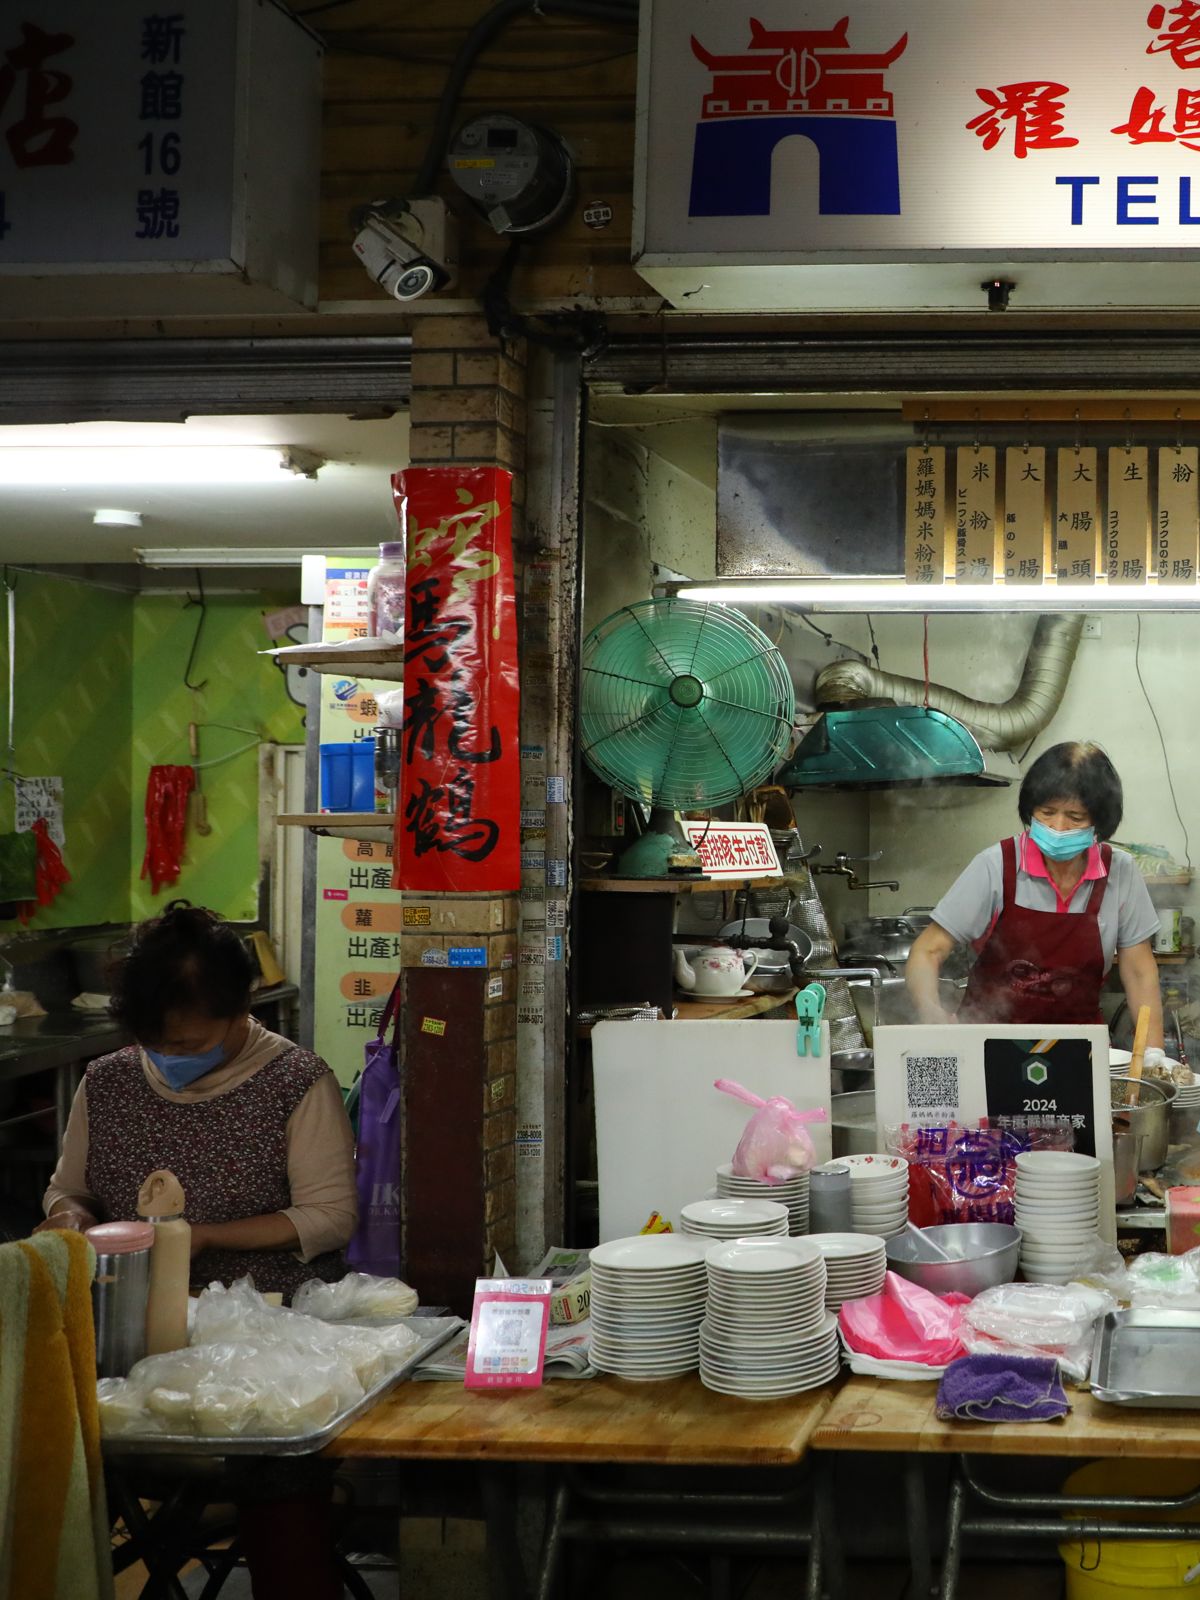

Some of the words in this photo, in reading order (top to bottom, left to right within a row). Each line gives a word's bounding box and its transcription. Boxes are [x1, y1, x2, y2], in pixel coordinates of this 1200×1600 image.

[135, 14, 186, 239] 新館16號
[914, 457, 937, 583] 羅媽媽米粉湯
[969, 462, 992, 578] 米粉湯
[1018, 462, 1042, 578] 大腸
[1070, 462, 1093, 578] 大腸頭
[1121, 462, 1144, 578] 生腸
[1171, 462, 1195, 578] 粉腸
[997, 1114, 1086, 1129] 年度嚴選商家
[1023, 1099, 1057, 1111] 2024
